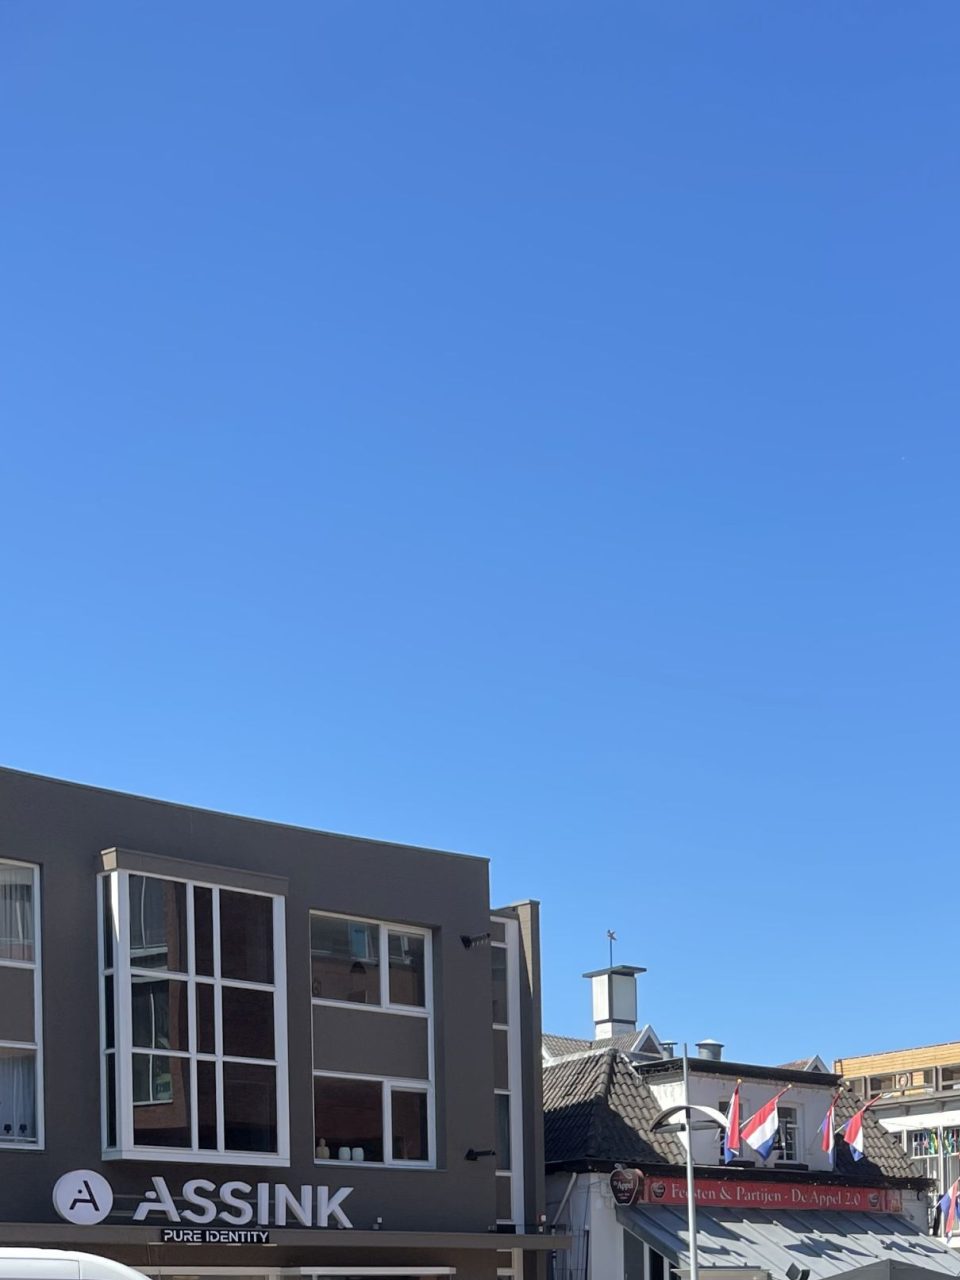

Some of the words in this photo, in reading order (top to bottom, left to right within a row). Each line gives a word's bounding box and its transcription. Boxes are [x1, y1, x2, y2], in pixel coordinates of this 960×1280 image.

[132, 1176, 354, 1229] ASSINK
[736, 1186, 782, 1204] Partijen
[791, 1188, 807, 1203] De
[810, 1190, 841, 1207] Appel
[163, 1230, 202, 1242] PURE
[205, 1231, 270, 1243] IDENTITY
